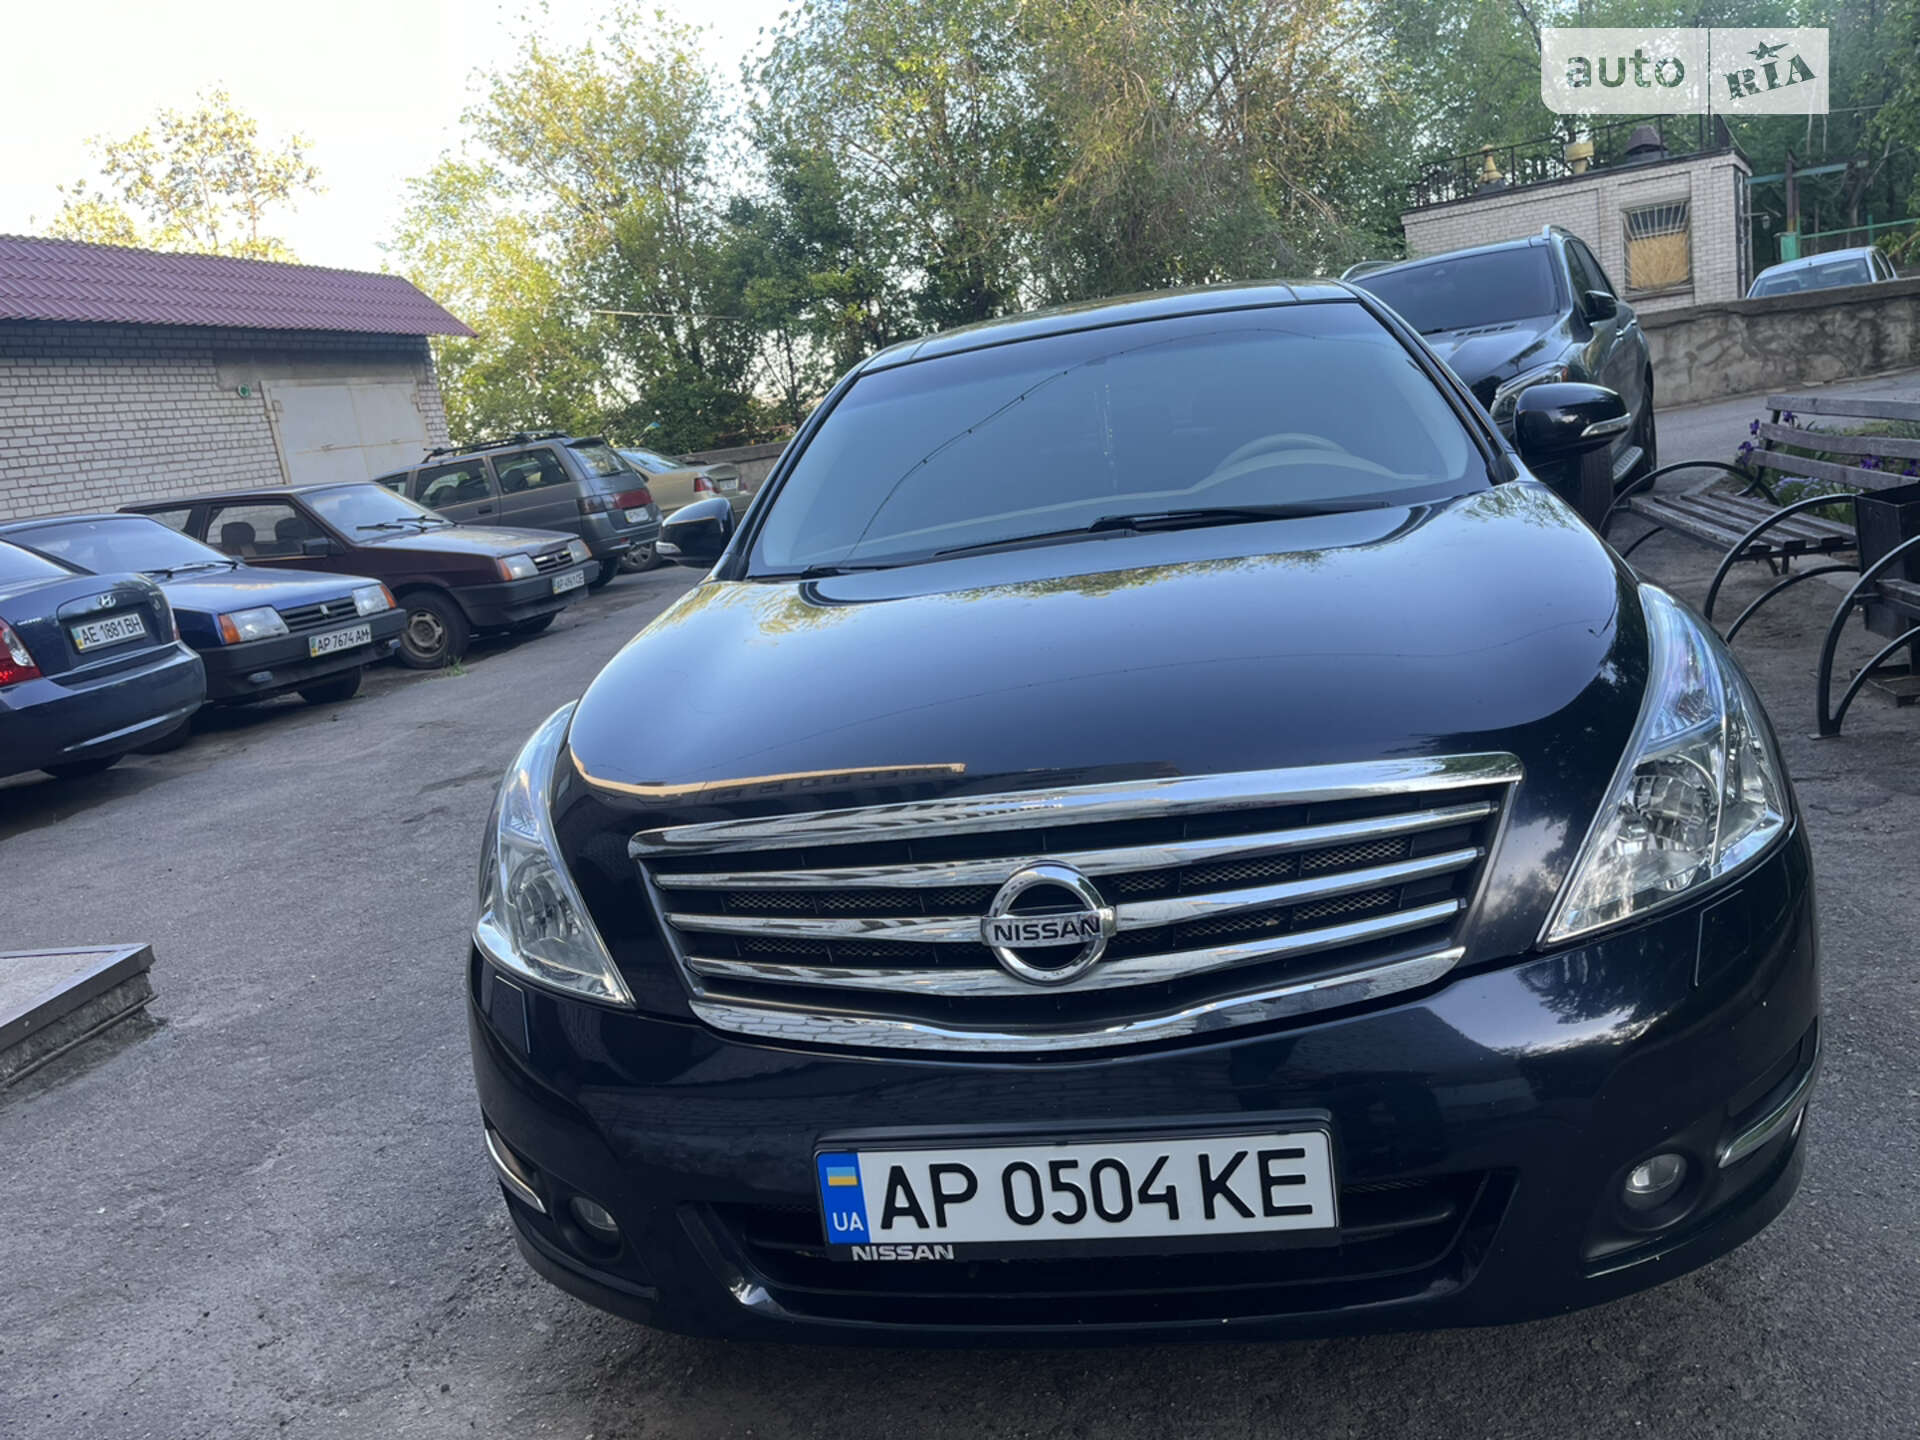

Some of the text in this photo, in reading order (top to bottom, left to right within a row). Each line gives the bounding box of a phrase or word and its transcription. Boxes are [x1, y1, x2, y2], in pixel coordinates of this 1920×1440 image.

[82, 615, 143, 645] AE 1881 BH
[318, 628, 370, 651] AP 7674 AM
[993, 915, 1101, 942] NISSAN
[880, 1147, 1314, 1230] AP 0504 KE
[833, 1211, 864, 1232] UA
[850, 1244, 954, 1261] NISSAN
